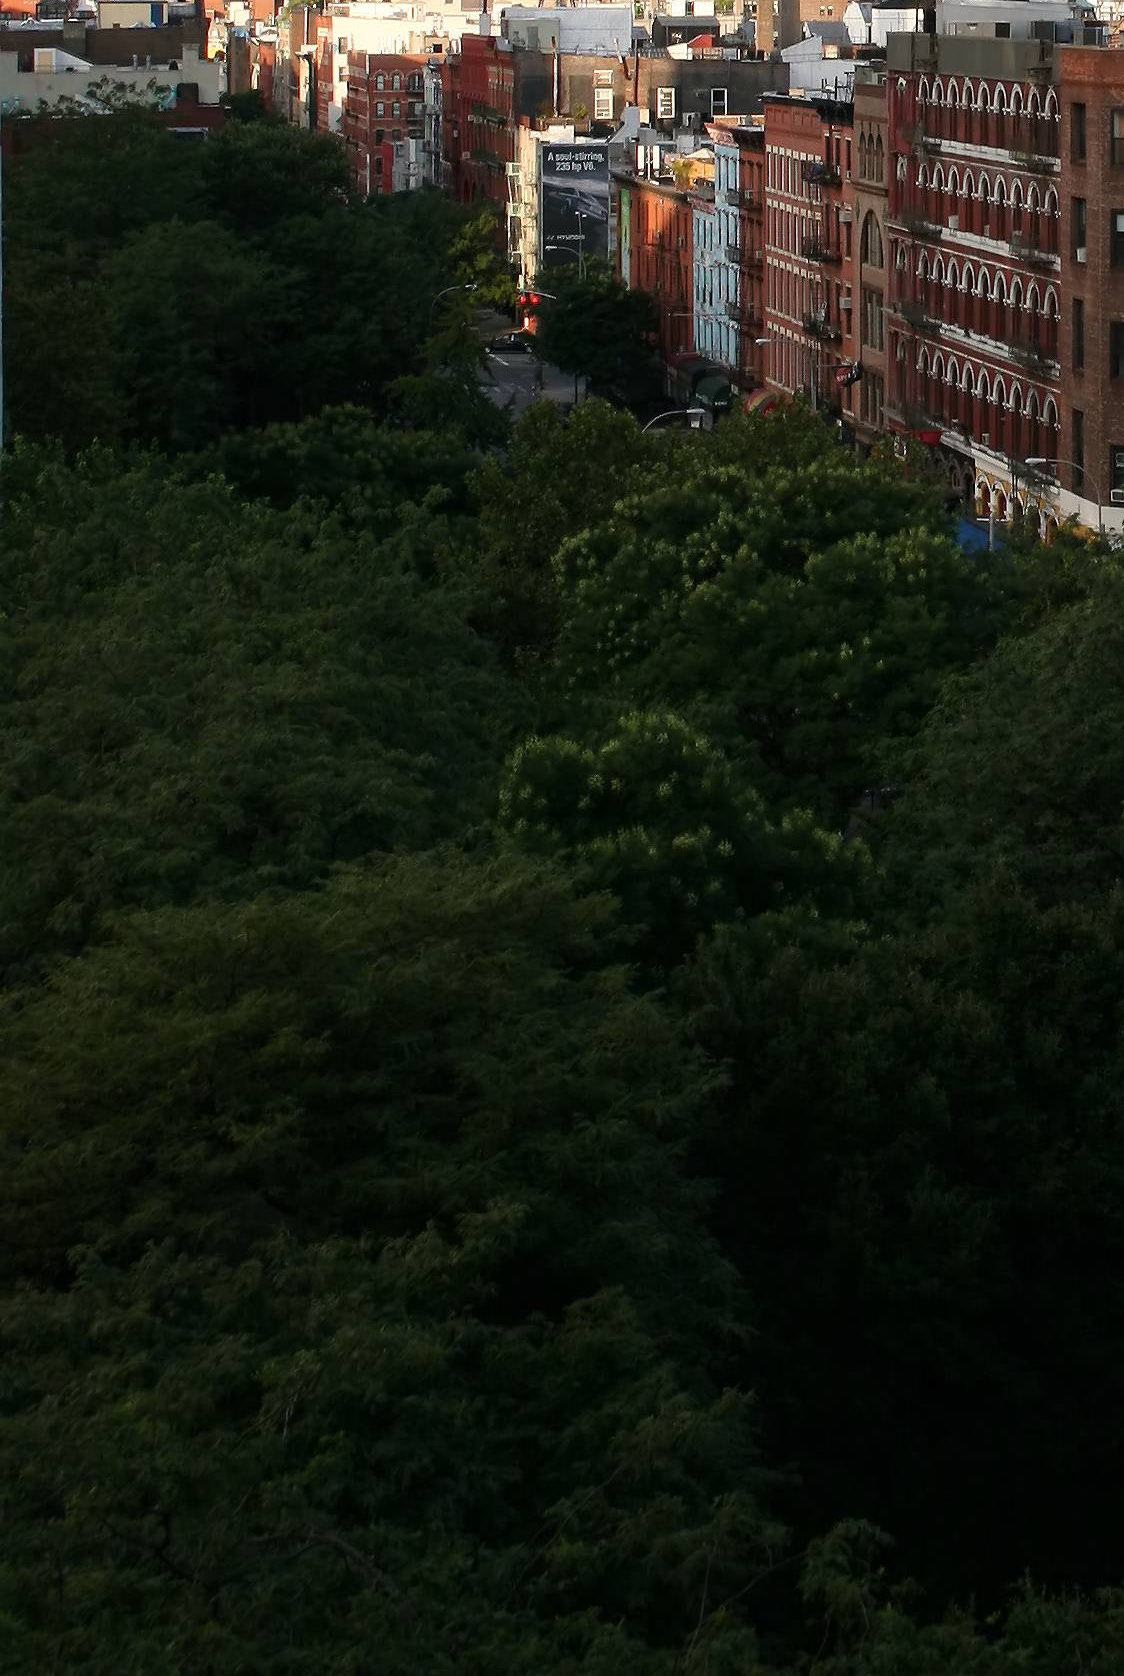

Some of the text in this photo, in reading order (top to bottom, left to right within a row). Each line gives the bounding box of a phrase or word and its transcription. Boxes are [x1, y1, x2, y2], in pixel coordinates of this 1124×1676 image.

[547, 152, 605, 162] A soul-stirring,
[556, 162, 571, 171] 235
[571, 162, 581, 172] hp
